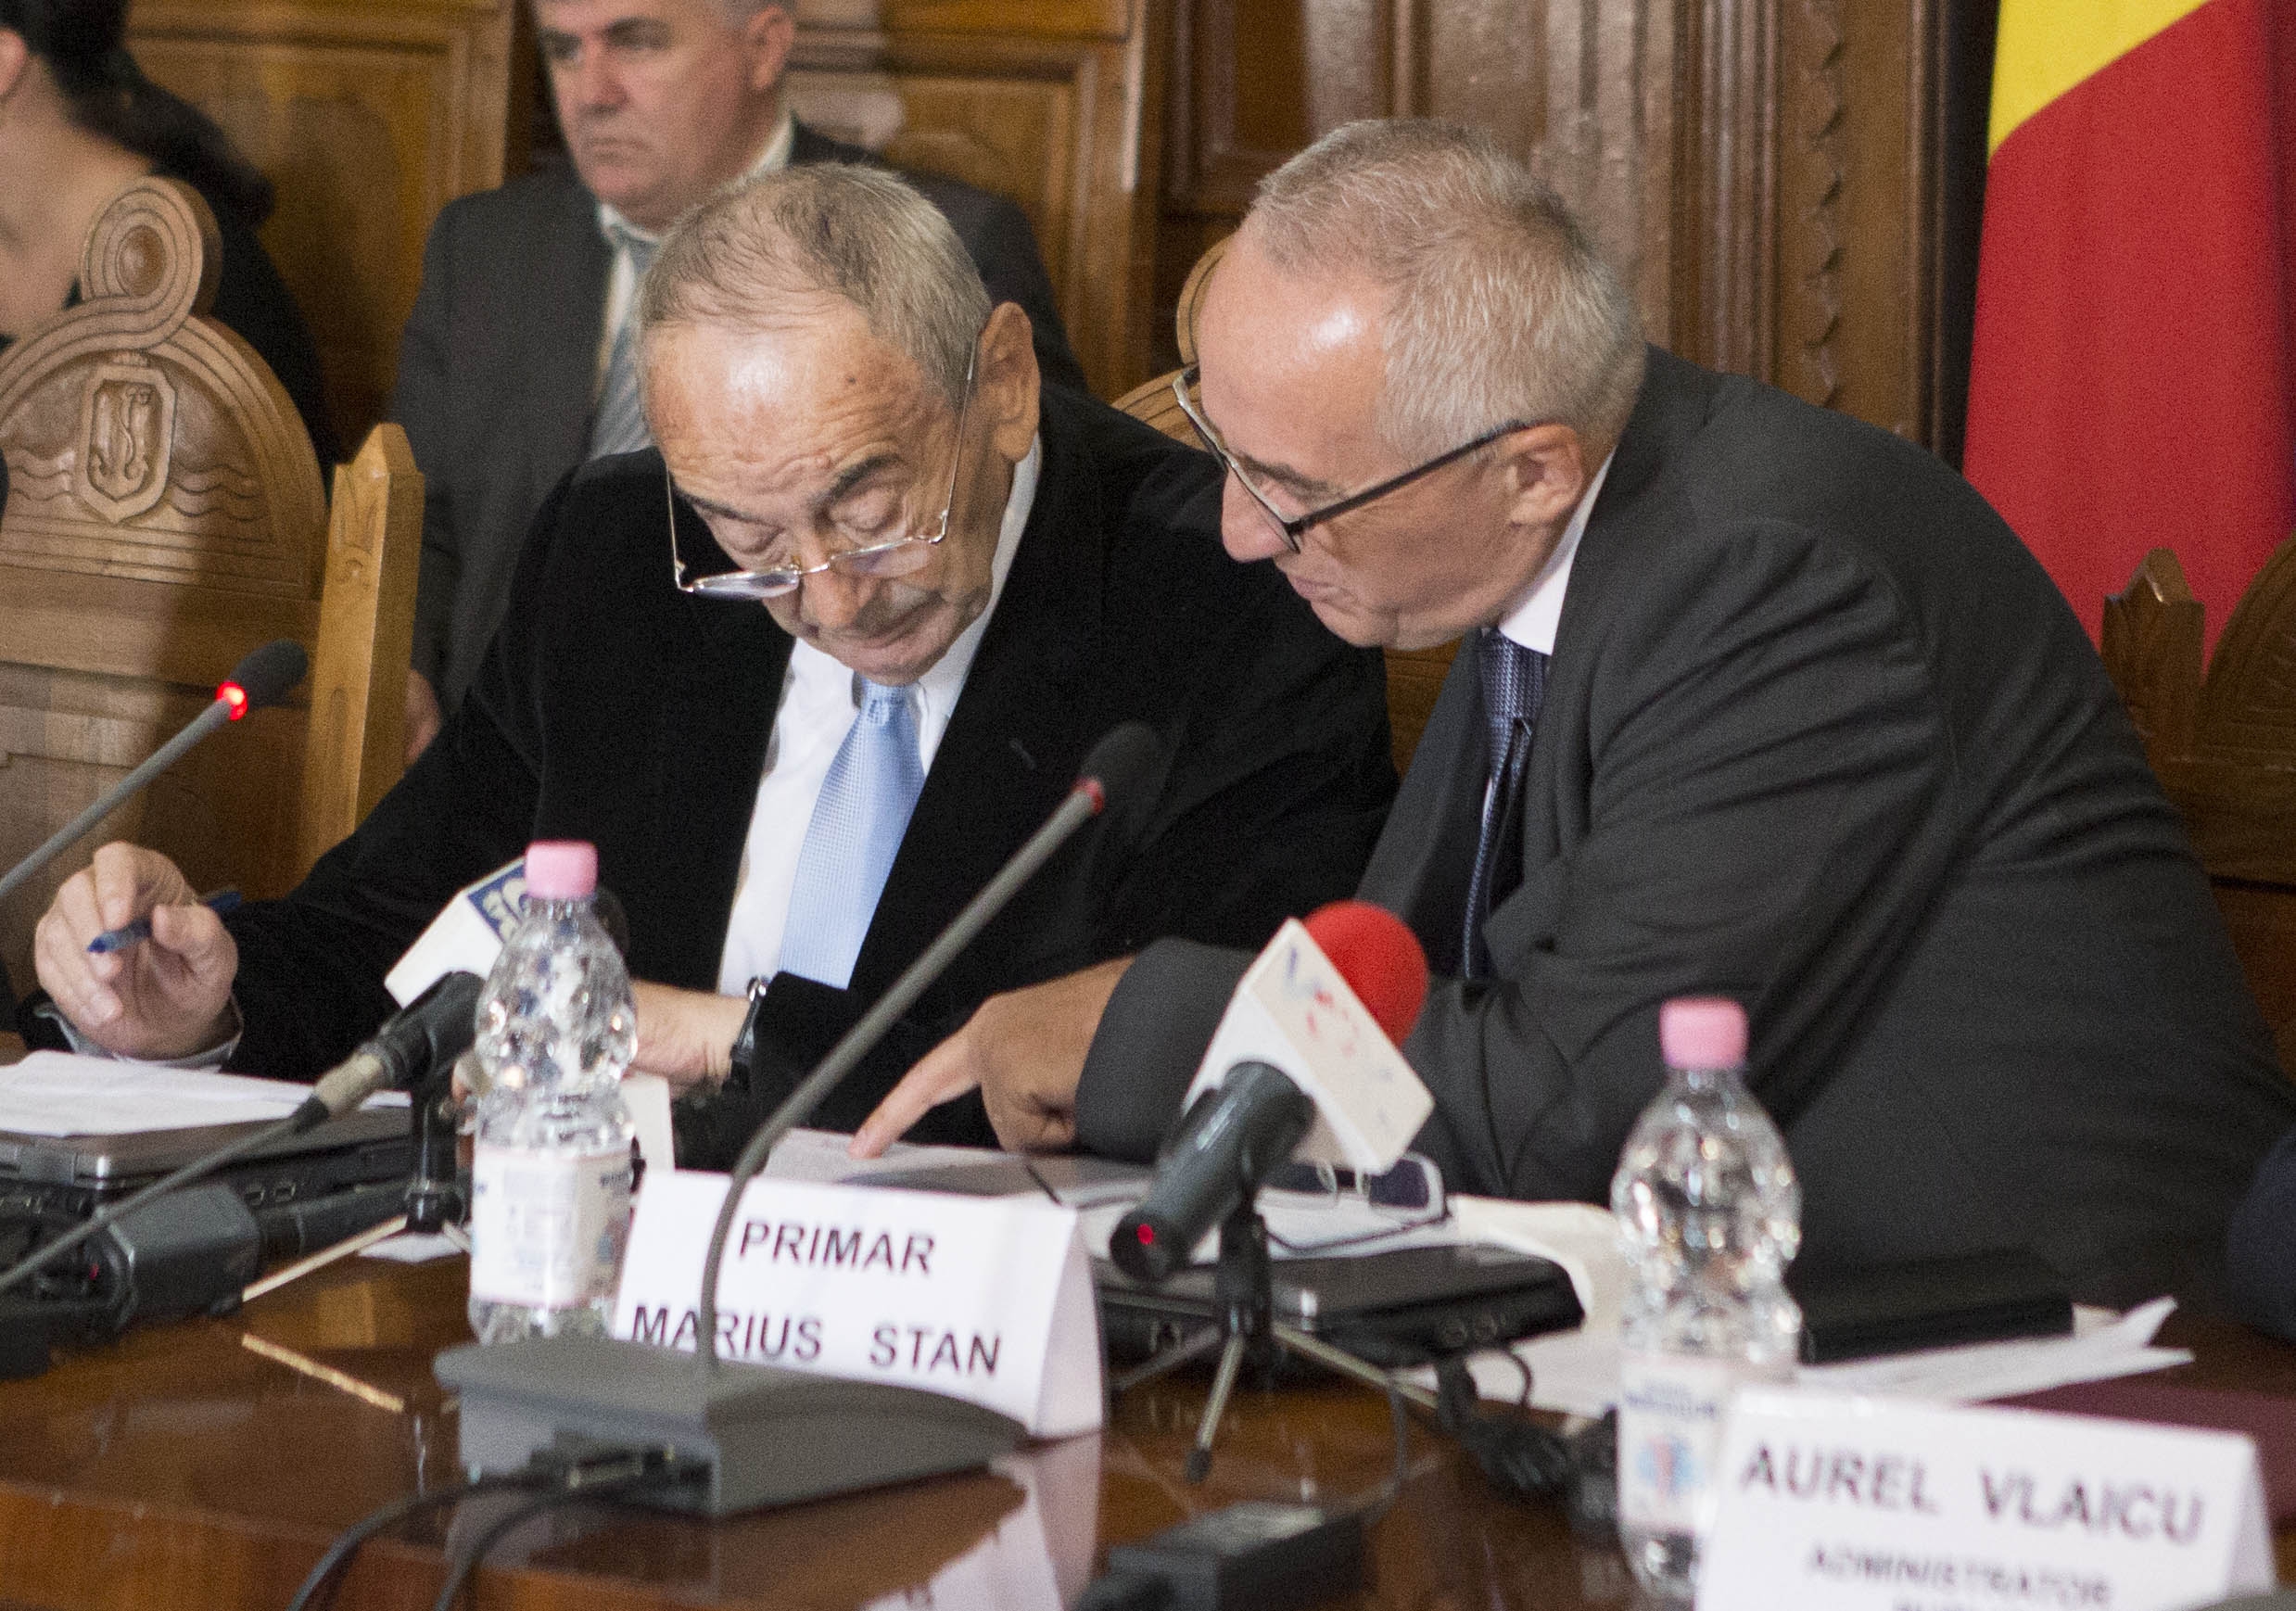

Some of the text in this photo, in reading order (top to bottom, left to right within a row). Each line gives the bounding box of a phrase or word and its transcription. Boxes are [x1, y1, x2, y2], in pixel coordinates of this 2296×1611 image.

[739, 1219, 935, 1275] PRIMAR
[630, 1304, 1002, 1376] MARIUS STAN
[1741, 1442, 2204, 1545] AUREL VLAICU
